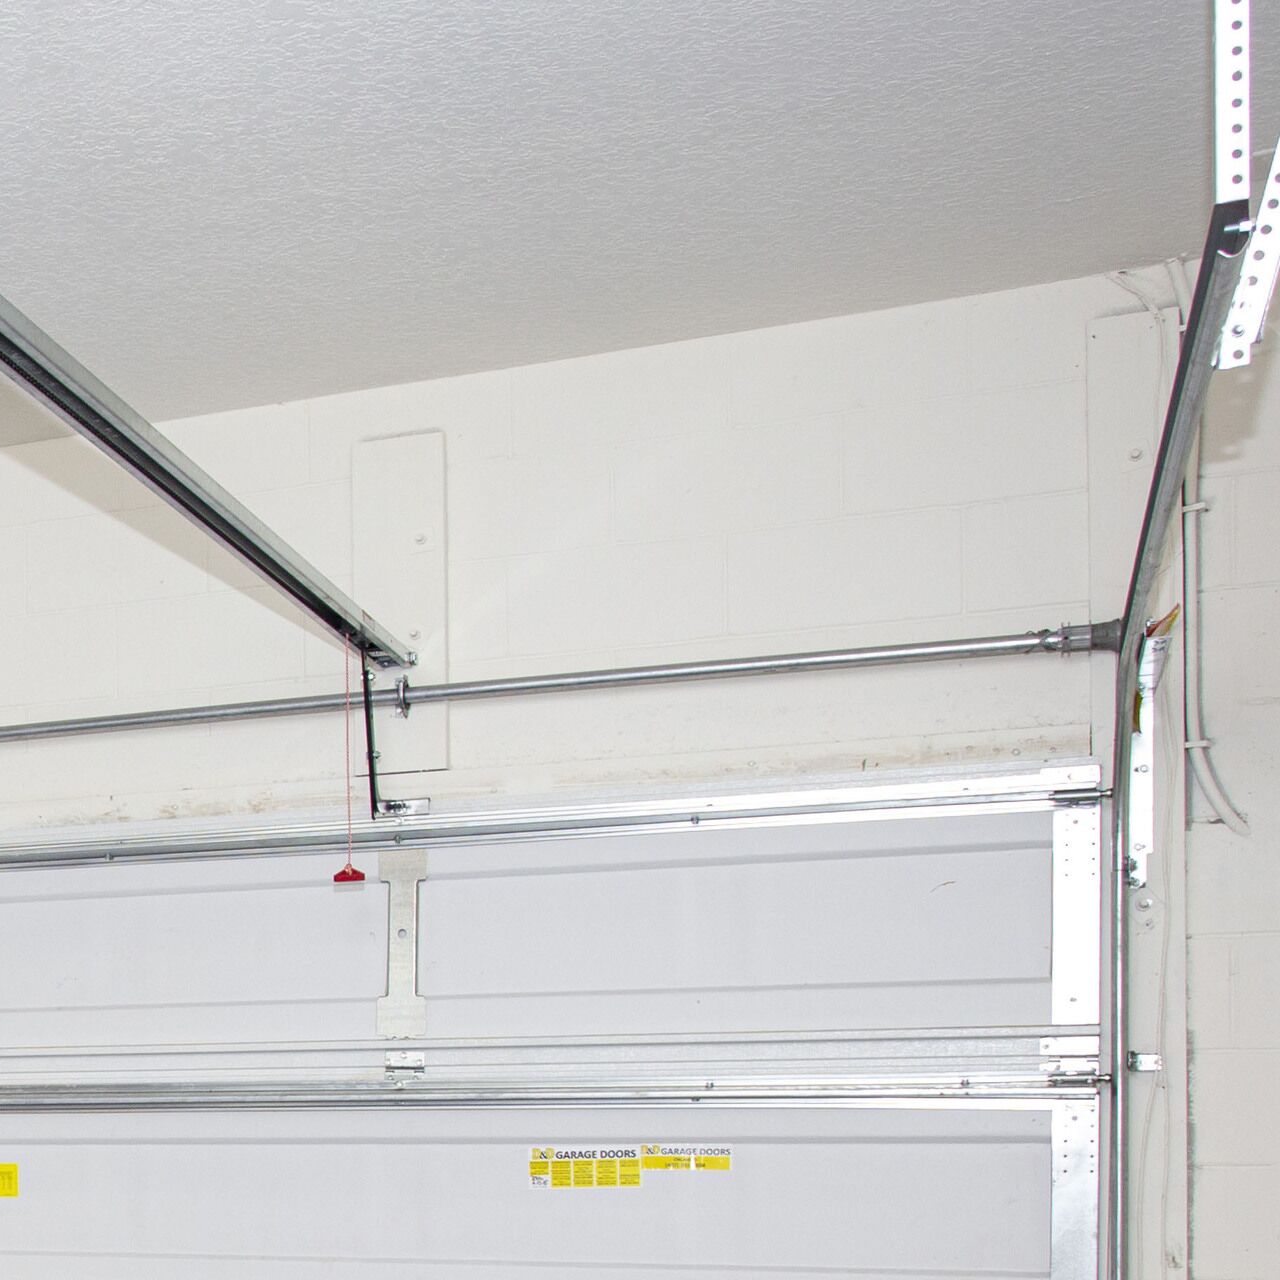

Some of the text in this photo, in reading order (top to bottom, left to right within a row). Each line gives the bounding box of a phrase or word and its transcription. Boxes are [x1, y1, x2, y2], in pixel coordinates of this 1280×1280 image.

[555, 1151, 597, 1159] GARAGE
[600, 1149, 637, 1159] DOORS
[700, 1148, 731, 1156] DOORS
